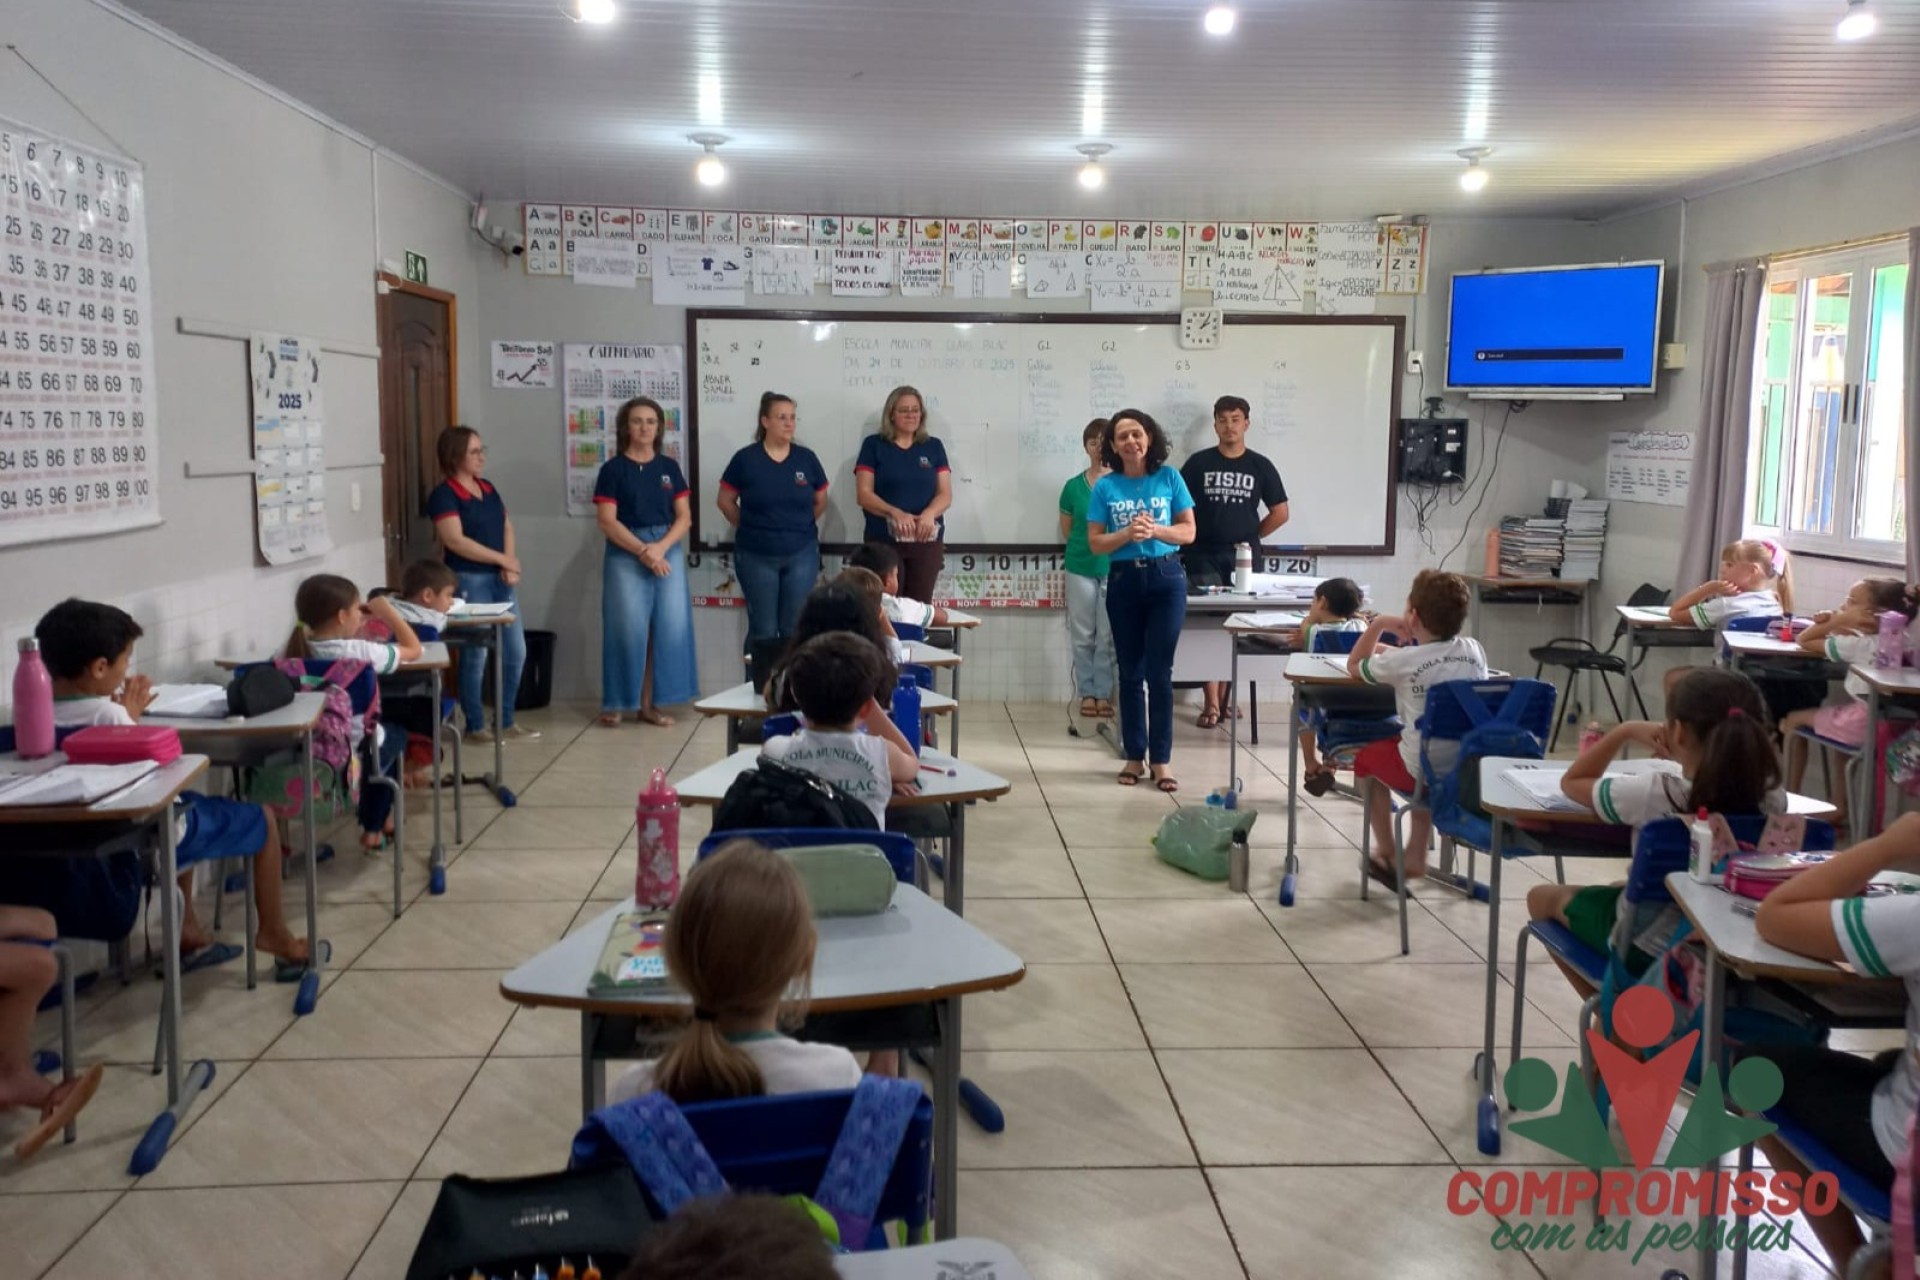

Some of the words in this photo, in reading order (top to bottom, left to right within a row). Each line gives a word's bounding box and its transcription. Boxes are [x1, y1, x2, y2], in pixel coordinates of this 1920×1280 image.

[2, 134, 11, 152] 5
[27, 142, 36, 160] 6
[52, 150, 62, 167] 7
[76, 156, 85, 174] 8
[95, 162, 104, 180] 9
[114, 170, 128, 188] 10
[1, 173, 18, 194] 15
[24, 180, 42, 201] 16
[51, 189, 67, 208] 17
[75, 193, 89, 212] 18
[96, 198, 111, 217] 19
[117, 204, 130, 224] 20
[529, 207, 540, 220] A
[564, 209, 574, 221] B
[600, 211, 610, 223] C
[635, 213, 645, 225] D
[671, 214, 681, 226] E
[706, 215, 715, 227] F
[742, 217, 752, 229] G
[845, 221, 854, 232] J
[879, 221, 890, 233] K
[914, 222, 922, 234] L
[949, 223, 960, 235] M
[983, 223, 993, 235] N
[1017, 224, 1028, 235] O
[1051, 224, 1060, 236] P
[1085, 224, 1096, 237] Q
[1120, 225, 1130, 237] R
[1154, 225, 1163, 237] S
[1188, 226, 1197, 237] T
[1222, 226, 1231, 238] U
[1256, 226, 1265, 239] V
[1290, 226, 1303, 239] W
[5, 215, 22, 236] 25
[51, 226, 70, 246] 27
[77, 231, 93, 251] 28
[98, 236, 113, 255] 29
[117, 242, 134, 260] 30
[571, 229, 595, 237] BOLA
[605, 231, 631, 239] CARRO
[642, 232, 665, 240] DADO
[713, 234, 734, 242] FOCA
[530, 240, 540, 250] A
[548, 241, 556, 250] a
[637, 243, 647, 255] D
[1188, 257, 1197, 267] T
[1206, 257, 1211, 267] t
[1392, 259, 1401, 270] Z
[8, 254, 25, 275] 35
[34, 258, 48, 279] 36
[52, 263, 70, 282] 37
[77, 266, 95, 286] 38
[100, 270, 115, 289] 39
[119, 275, 137, 293] 40
[11, 293, 27, 313] 45
[36, 296, 52, 316] 46
[56, 300, 71, 318] 47
[78, 303, 96, 321] 48
[101, 305, 115, 323] 49
[123, 309, 139, 326] 50
[14, 331, 30, 350] 55
[39, 334, 57, 353] 56
[60, 336, 74, 354] 57
[81, 337, 97, 356] 58
[102, 340, 118, 358] 59
[126, 341, 140, 359] 60
[17, 371, 32, 391] 65
[41, 372, 61, 391] 66
[65, 374, 78, 392] 67
[84, 374, 99, 392] 68
[104, 375, 122, 392] 69
[129, 376, 142, 394] 70
[278, 393, 302, 409] 2025
[19, 411, 35, 430] 75
[43, 411, 63, 429] 76
[69, 411, 81, 429] 77
[87, 411, 103, 428] 78
[108, 411, 126, 427] 79
[131, 411, 144, 428] 80
[22, 450, 39, 469] 85
[46, 448, 65, 467] 86
[73, 448, 85, 466] 87
[90, 447, 107, 464] 88
[112, 446, 128, 463] 89
[133, 445, 146, 462] 90
[1203, 471, 1255, 490] FISIO
[1, 490, 17, 510] 94
[25, 488, 43, 507] 95
[49, 486, 67, 505] 96
[75, 484, 90, 503] 97
[94, 482, 110, 500] 98
[115, 480, 129, 497] 99
[133, 479, 149, 496] 100
[962, 555, 975, 571] 9
[987, 555, 1010, 571] 10
[1019, 555, 1039, 571] 11
[1286, 560, 1310, 573] 20
[719, 598, 734, 606] UM
[815, 747, 874, 773] MUNICIPAL
